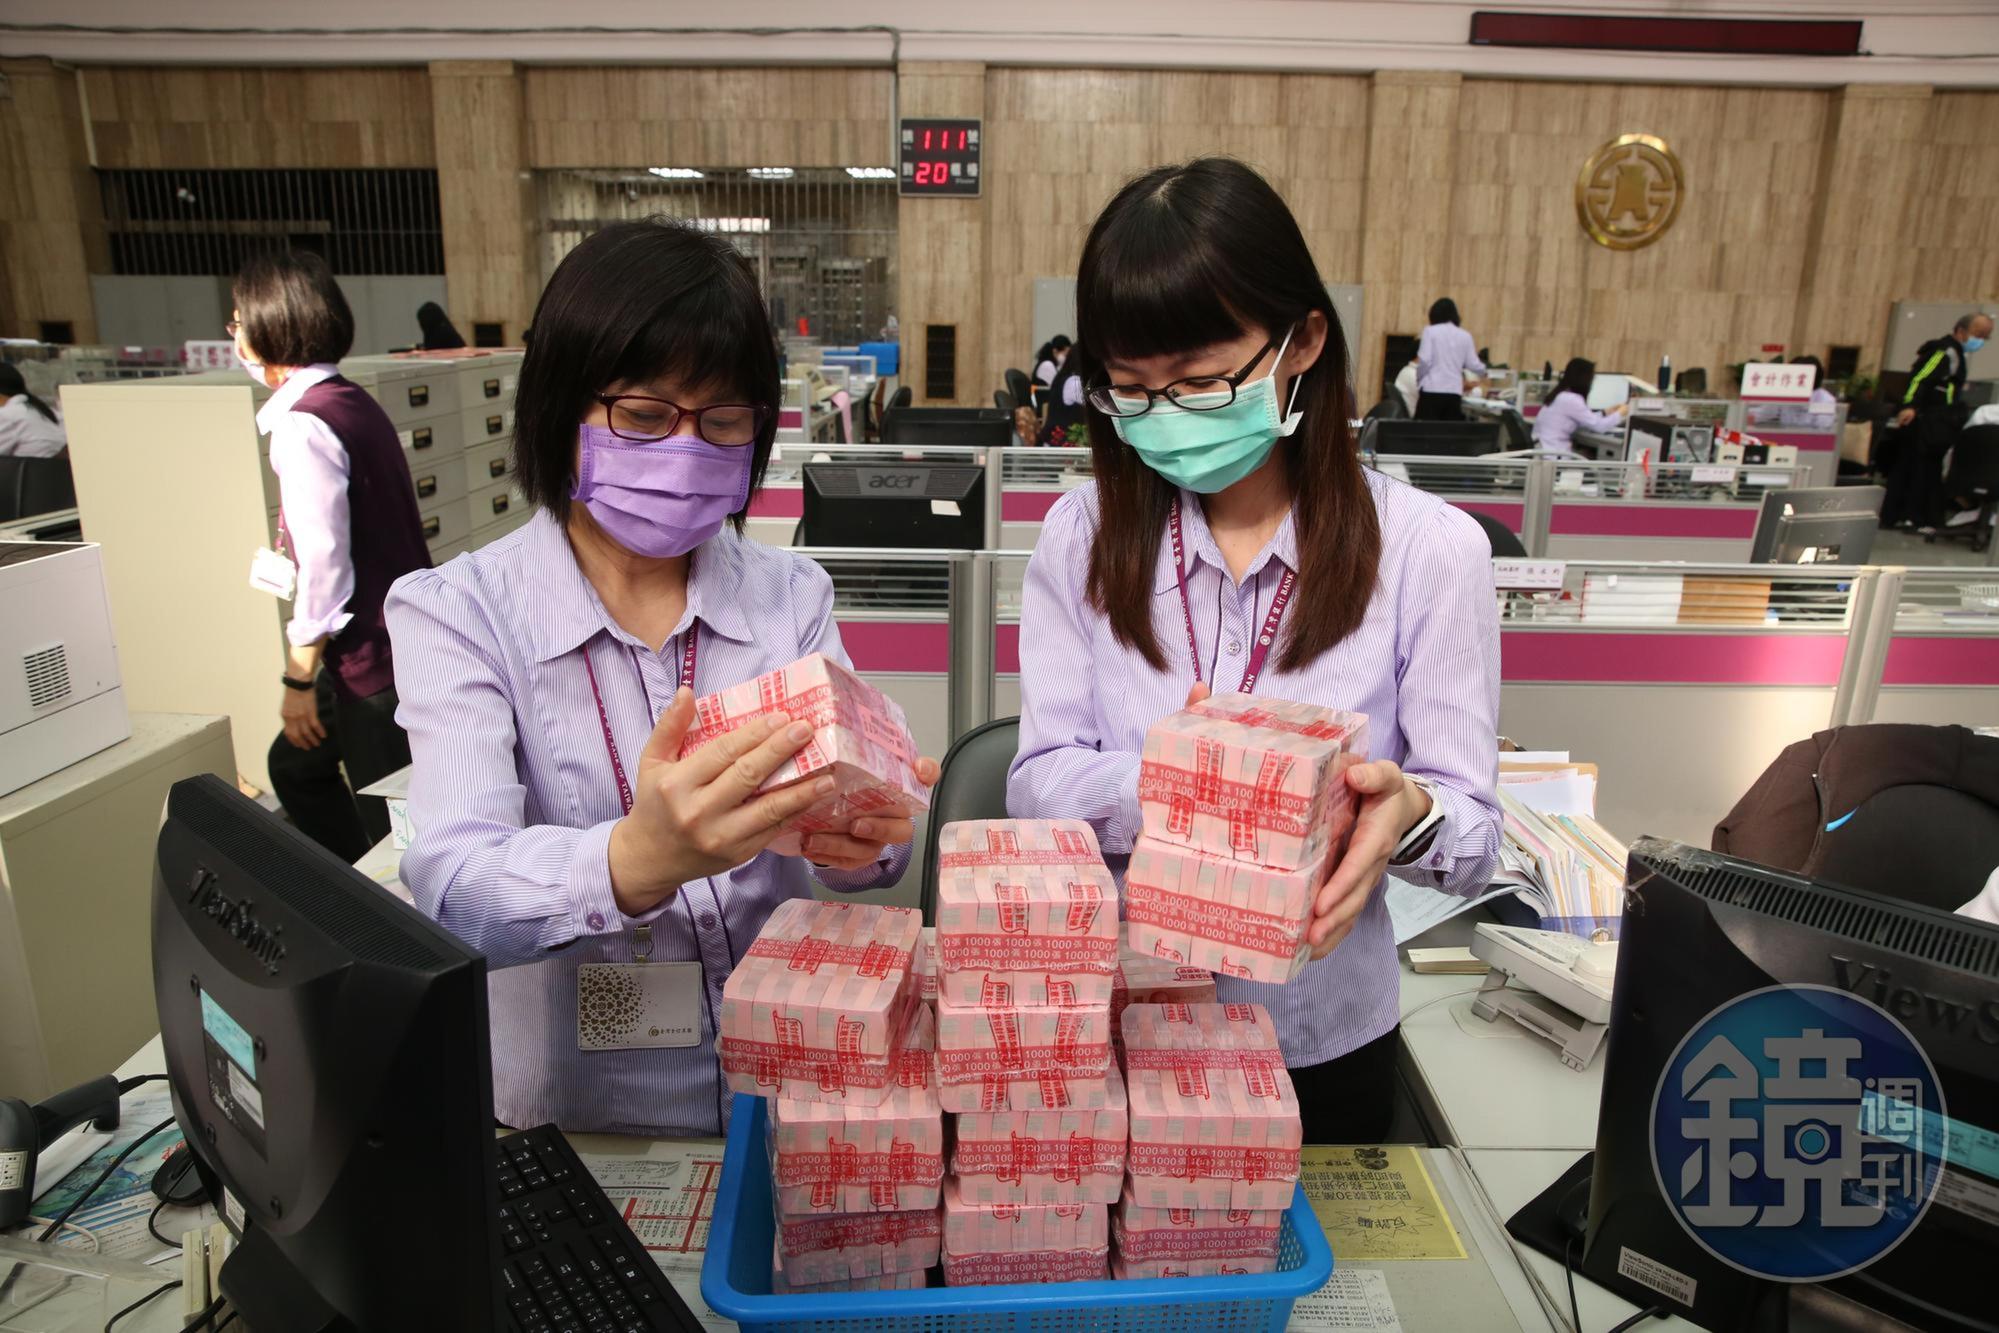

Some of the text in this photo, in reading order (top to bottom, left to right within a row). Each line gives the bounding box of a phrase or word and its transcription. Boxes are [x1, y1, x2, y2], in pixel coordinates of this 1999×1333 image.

[924, 129, 966, 150] 111
[915, 161, 948, 184] 20
[868, 474, 920, 489] acer
[1280, 572, 1296, 597] BANK
[1242, 673, 1256, 694] WAN
[617, 767, 625, 779] OF
